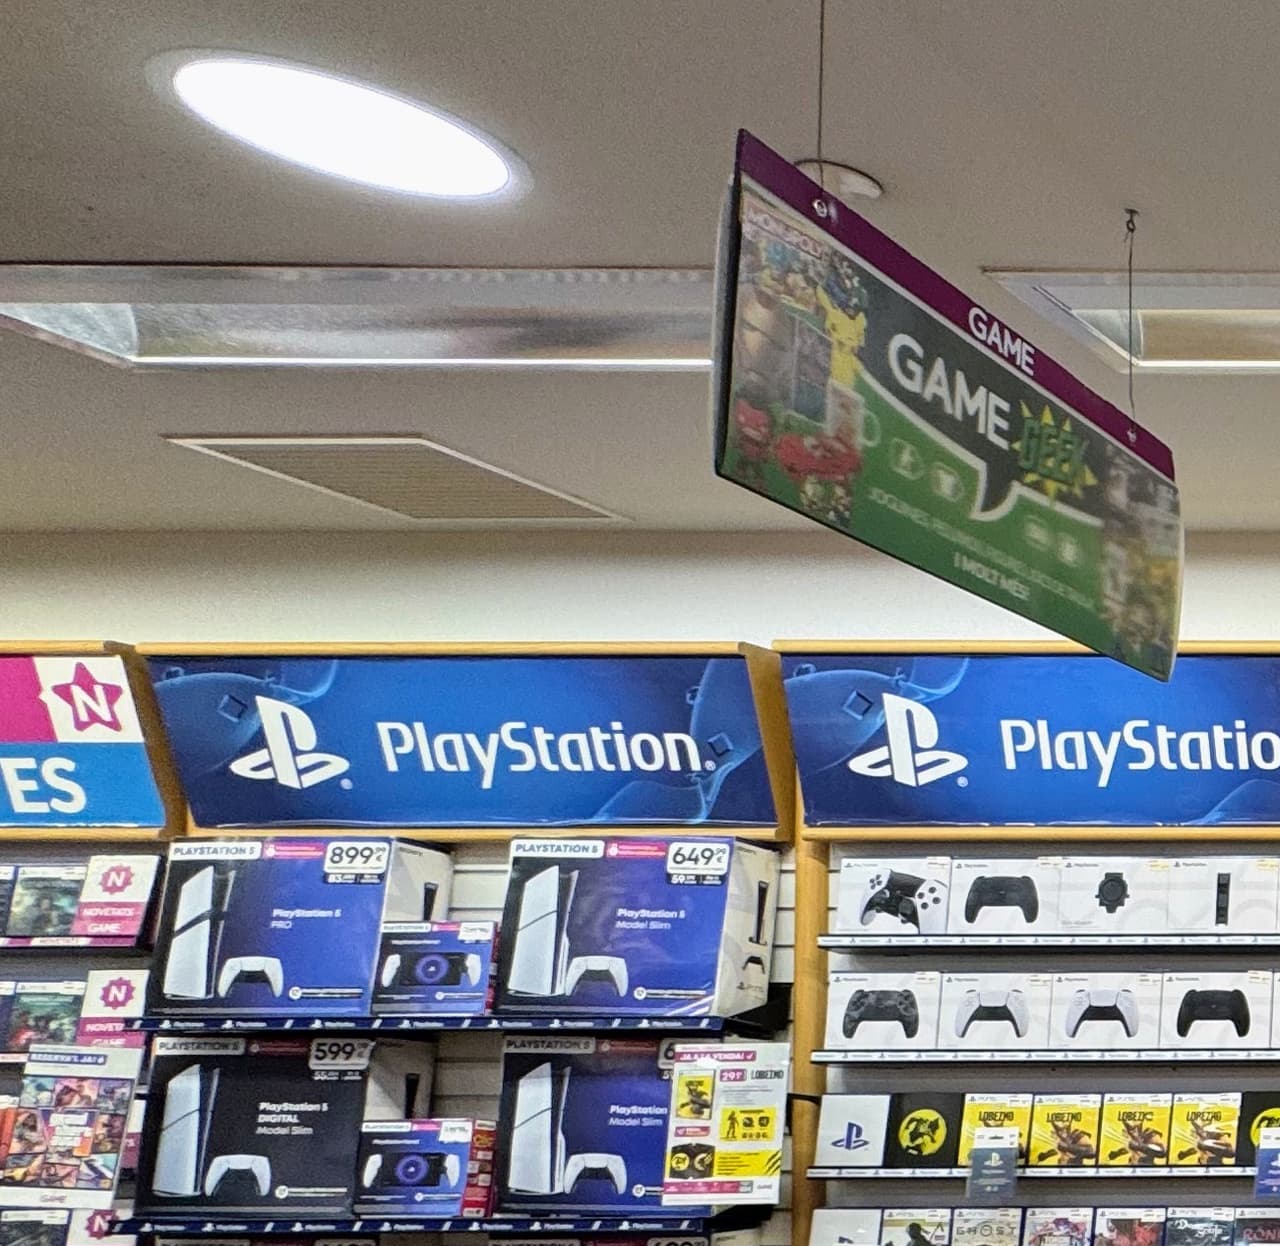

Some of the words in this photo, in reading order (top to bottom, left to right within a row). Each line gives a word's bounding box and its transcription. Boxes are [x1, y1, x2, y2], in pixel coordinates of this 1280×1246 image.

[968, 307, 1034, 376] GAME
[888, 334, 1011, 450] GAME
[73, 684, 109, 723] N
[379, 722, 697, 788] PlayStation
[515, 843, 587, 854] PLAYSTATION
[272, 909, 332, 920] PlayStation
[271, 920, 292, 930] PRO
[616, 920, 646, 930] Model
[649, 920, 671, 930] Slim
[258, 1114, 298, 1123] DIGITAL
[609, 1117, 639, 1127] Model
[641, 1117, 663, 1127] Slim
[256, 1126, 287, 1135] Model
[290, 1125, 313, 1135] Slim
